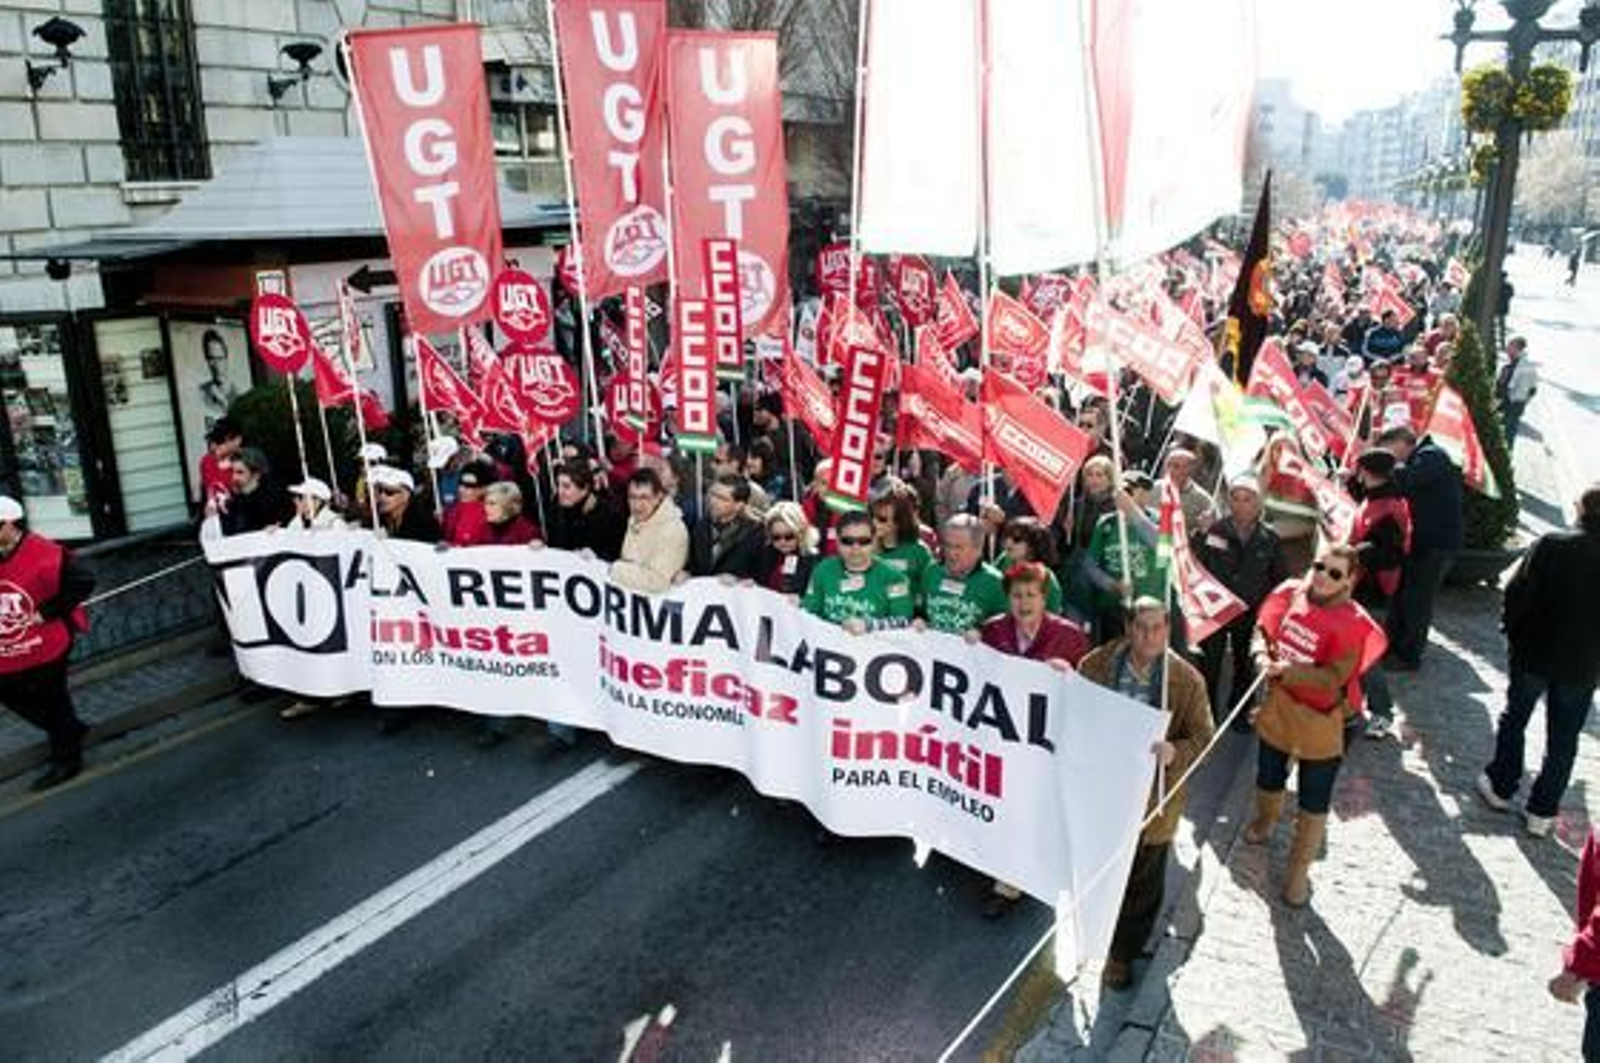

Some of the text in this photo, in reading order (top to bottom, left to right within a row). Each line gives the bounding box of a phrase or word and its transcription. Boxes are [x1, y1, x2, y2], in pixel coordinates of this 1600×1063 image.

[390, 44, 461, 240] UGT
[591, 11, 645, 202] UGT
[699, 47, 757, 240] UGT
[428, 253, 480, 283] UGT
[498, 283, 541, 312] UGT
[709, 241, 738, 363] CCOO
[259, 306, 299, 334] UGT
[519, 354, 567, 386] UGT
[681, 301, 709, 431] CCOO
[835, 350, 878, 495] CCOO
[369, 610, 550, 656] injusta
[401, 650, 434, 666] LOS
[448, 567, 741, 651] REFORMA
[754, 615, 1056, 754] LABORAL
[598, 634, 799, 726] ineficaz
[831, 717, 1003, 798] inútil
[832, 767, 996, 823] PARA EL EMPLEO
